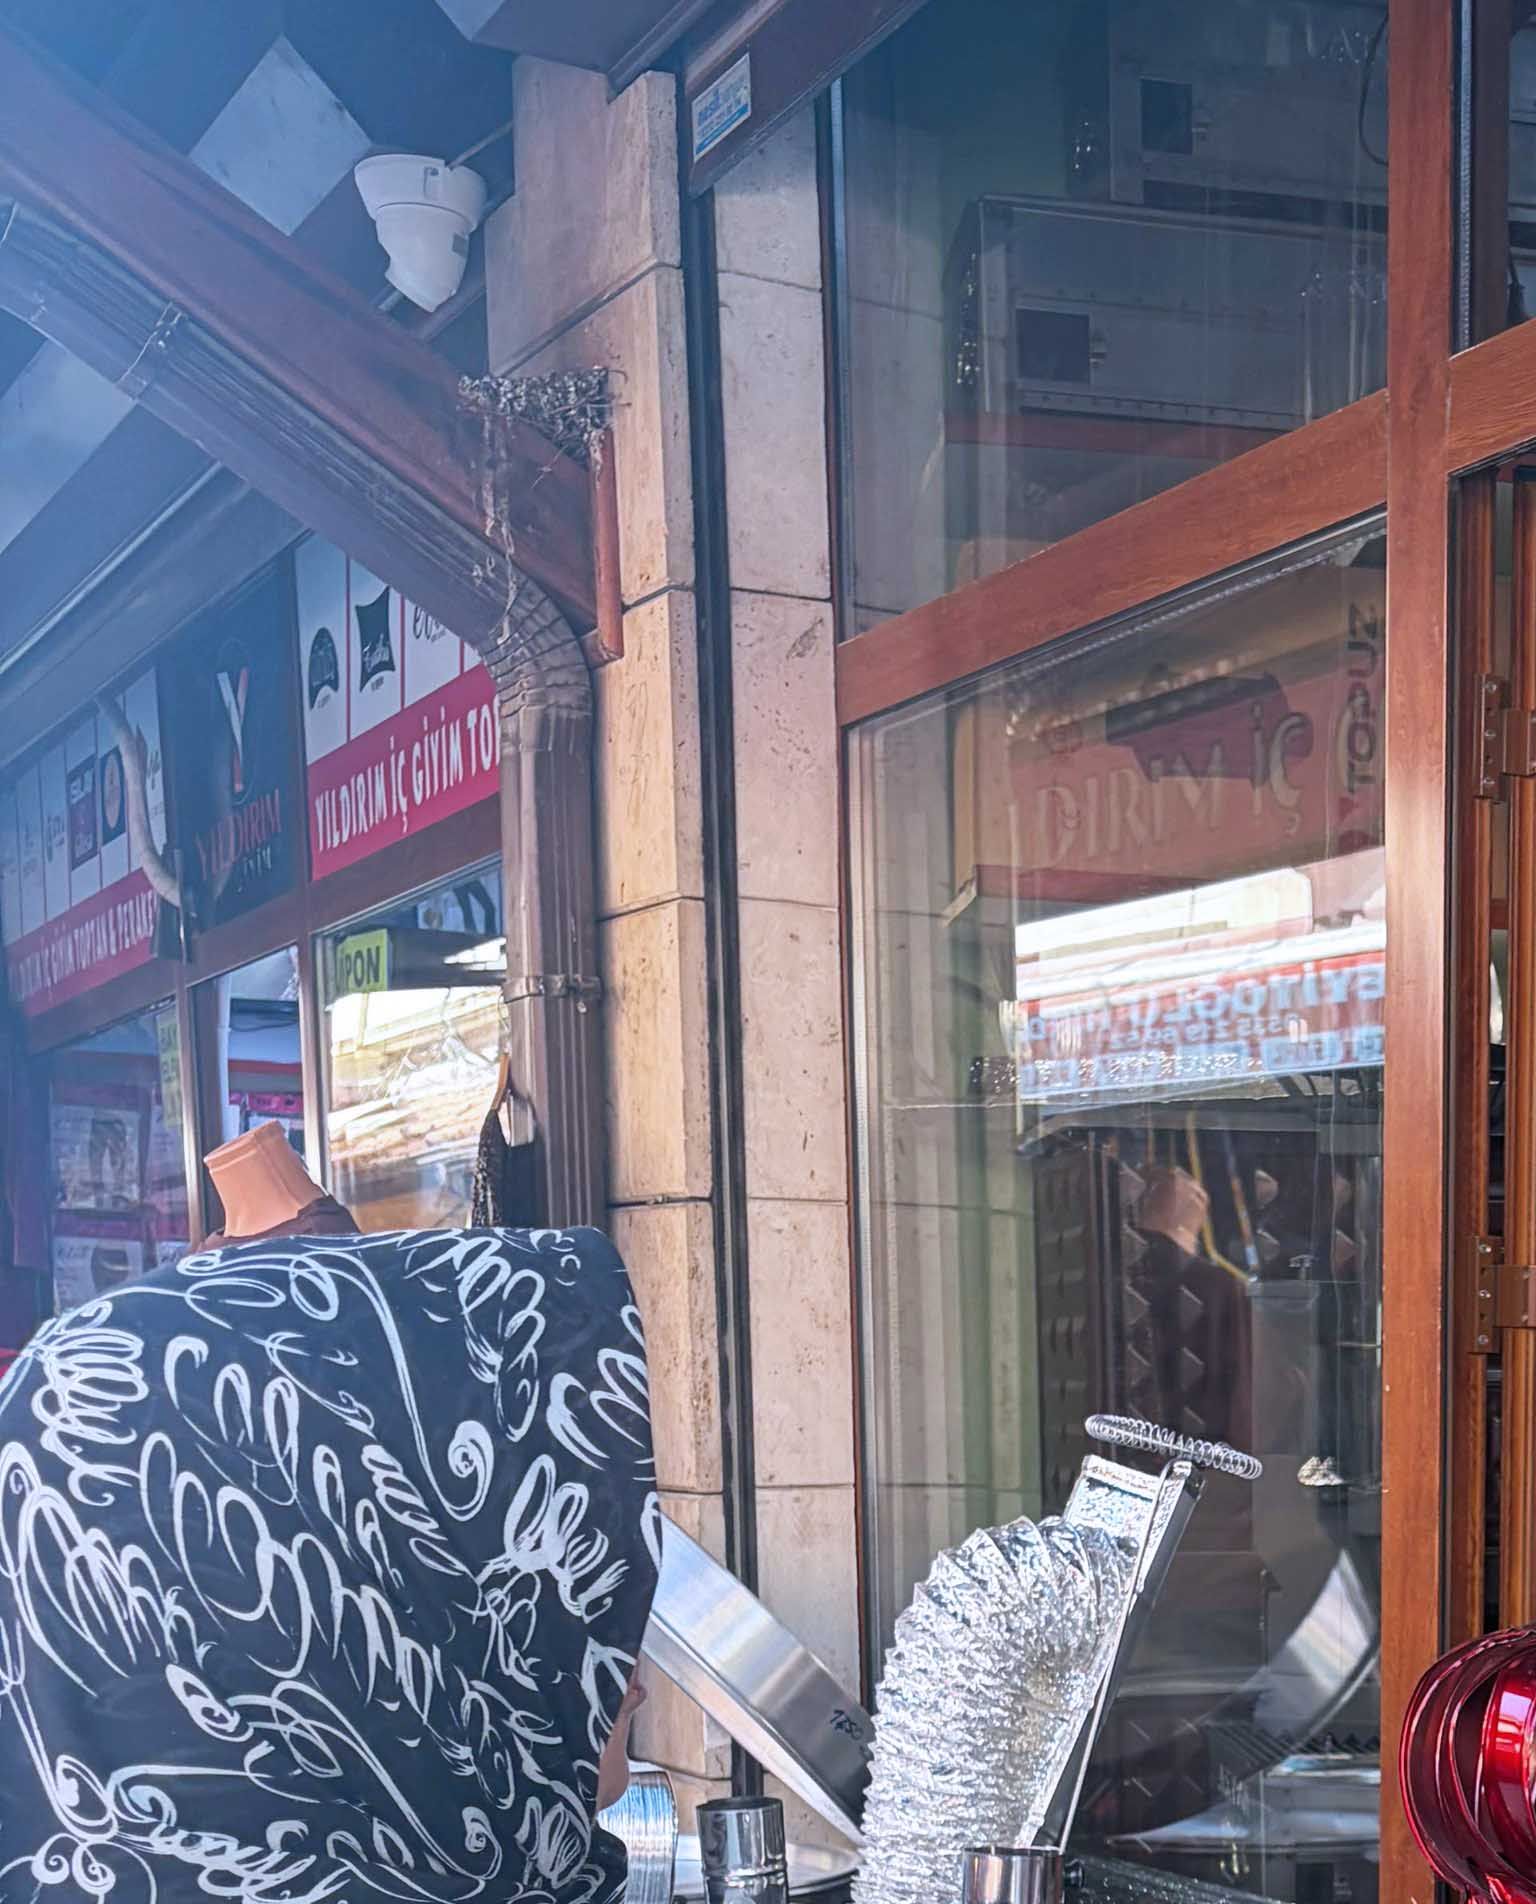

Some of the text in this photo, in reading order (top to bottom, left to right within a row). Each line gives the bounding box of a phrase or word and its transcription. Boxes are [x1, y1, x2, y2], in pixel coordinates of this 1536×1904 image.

[315, 761, 387, 851] YILDIRIM
[390, 735, 409, 833] İÇ
[411, 706, 464, 806] GİYİM
